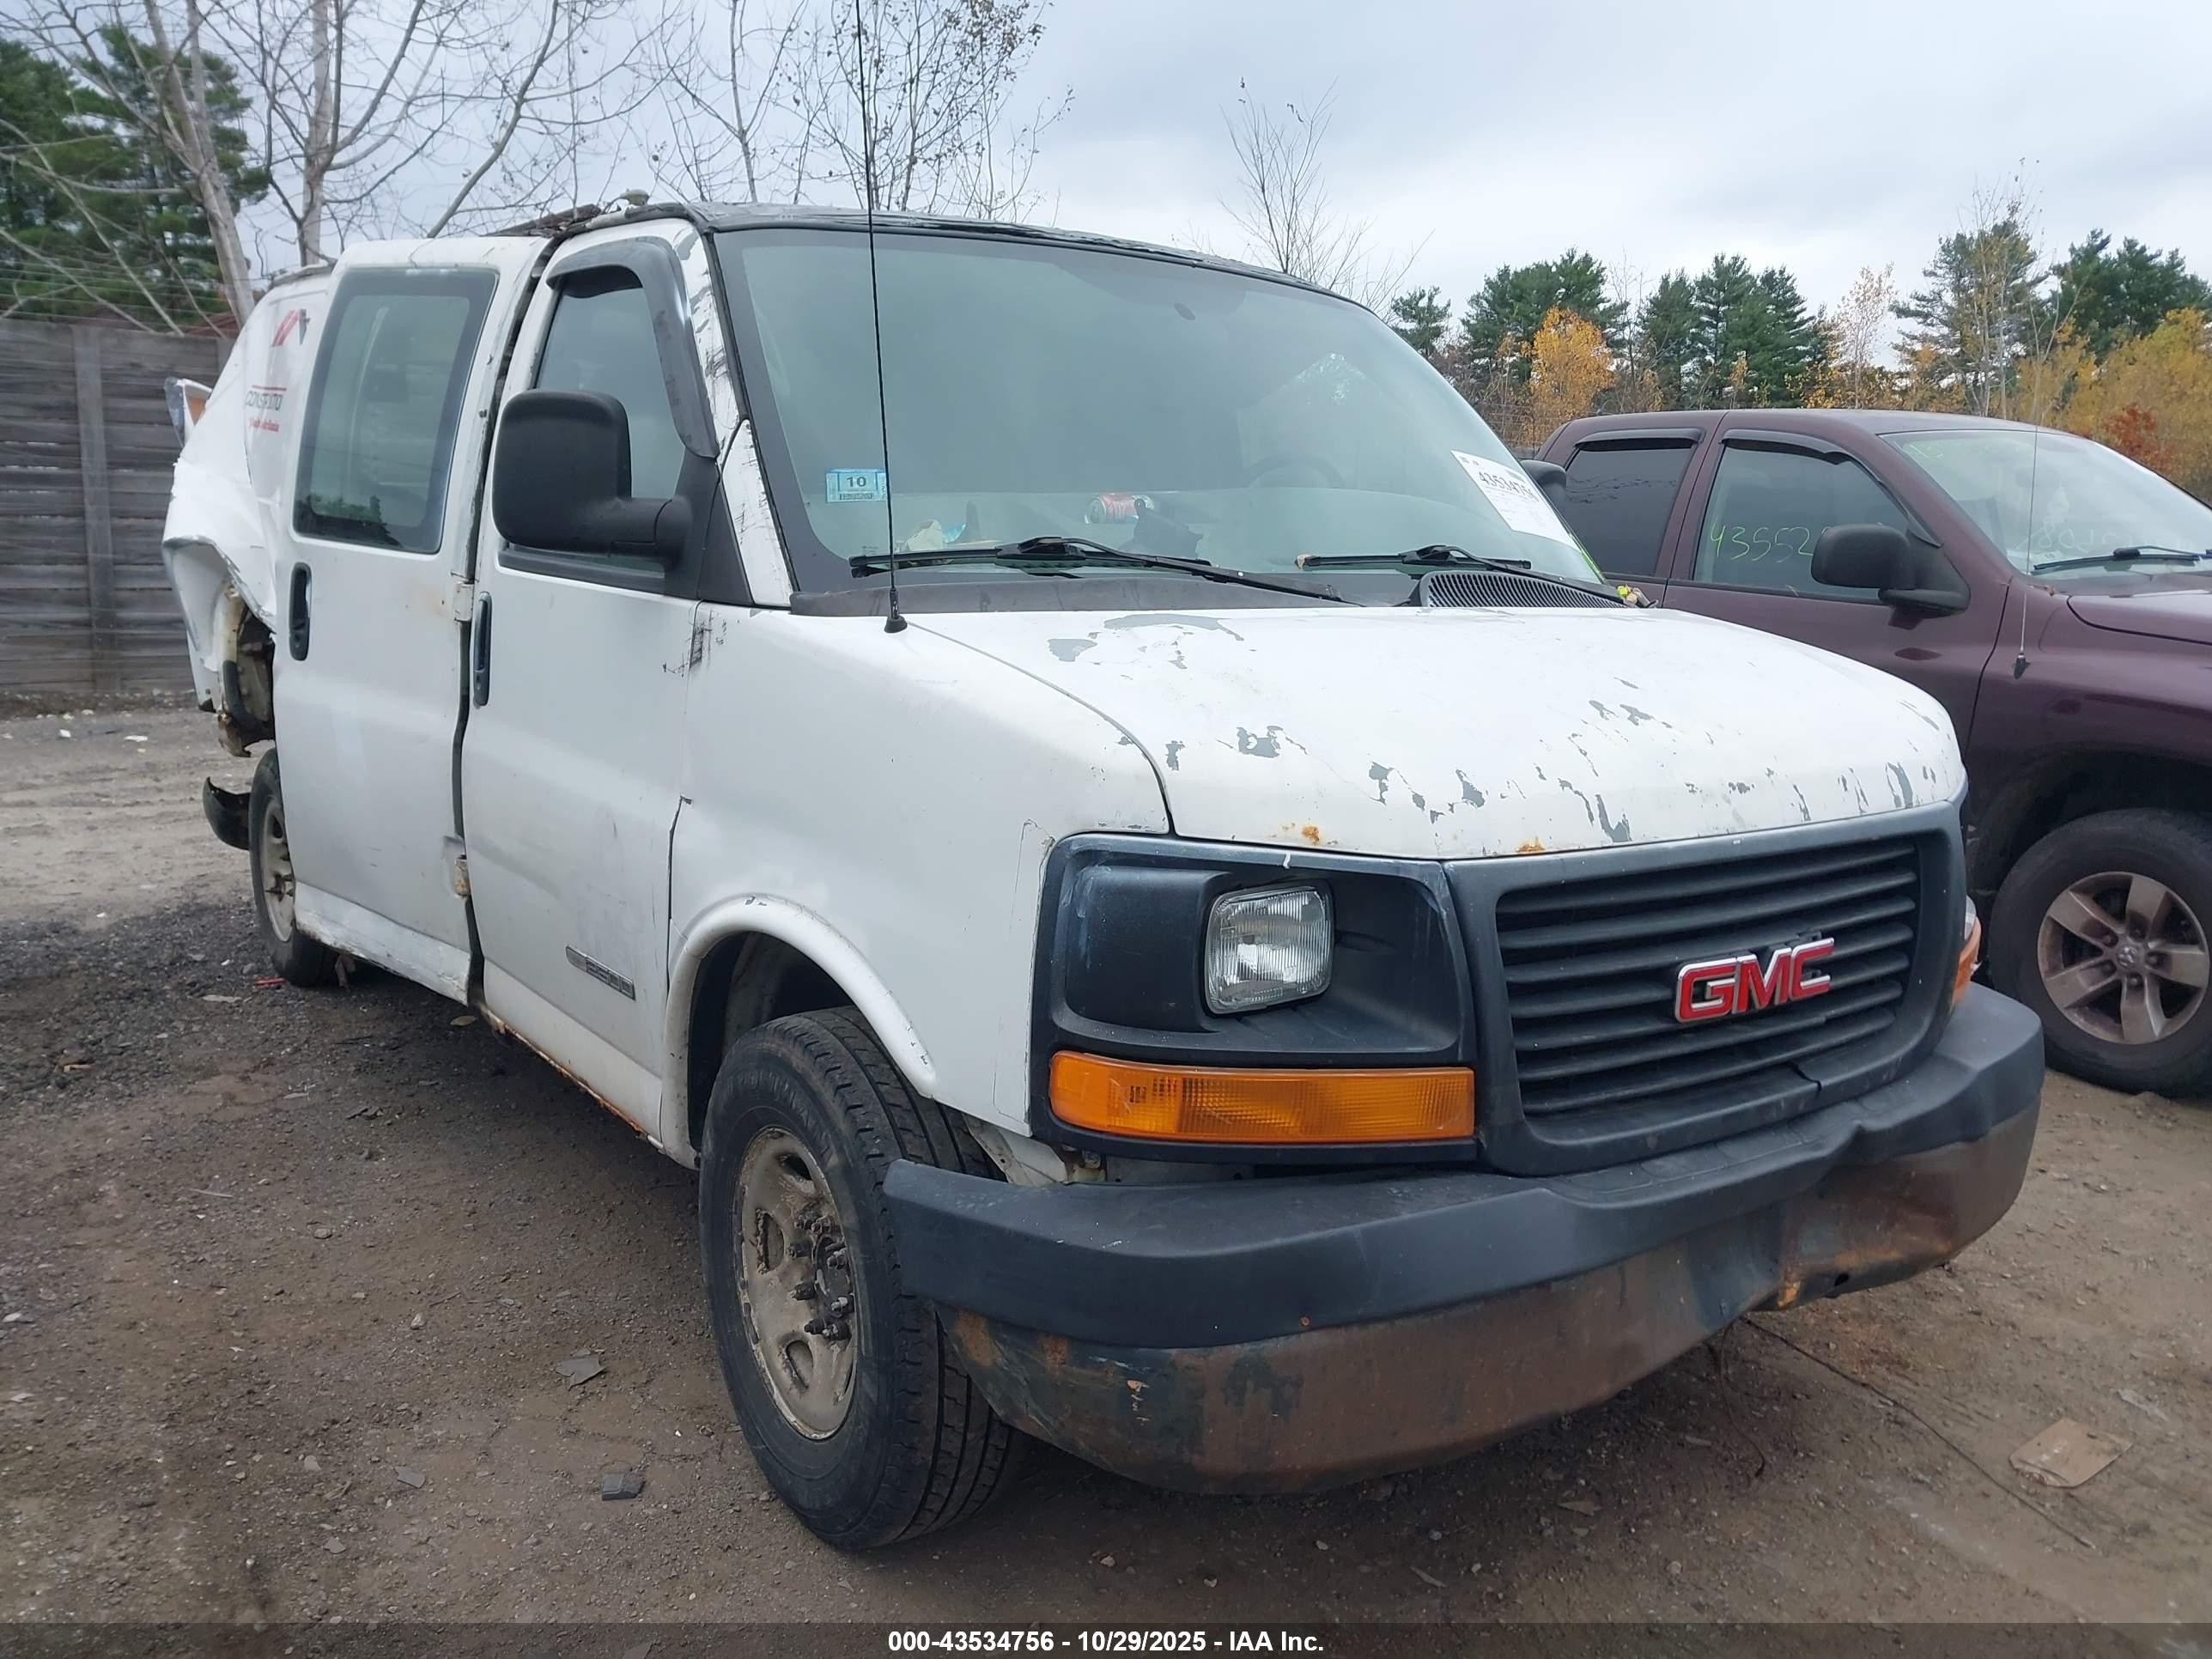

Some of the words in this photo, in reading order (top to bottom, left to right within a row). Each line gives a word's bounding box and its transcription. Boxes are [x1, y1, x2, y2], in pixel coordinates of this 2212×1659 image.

[847, 477, 866, 487] 10
[1711, 525, 1830, 563] 43552
[1675, 937, 1834, 1023] GMC
